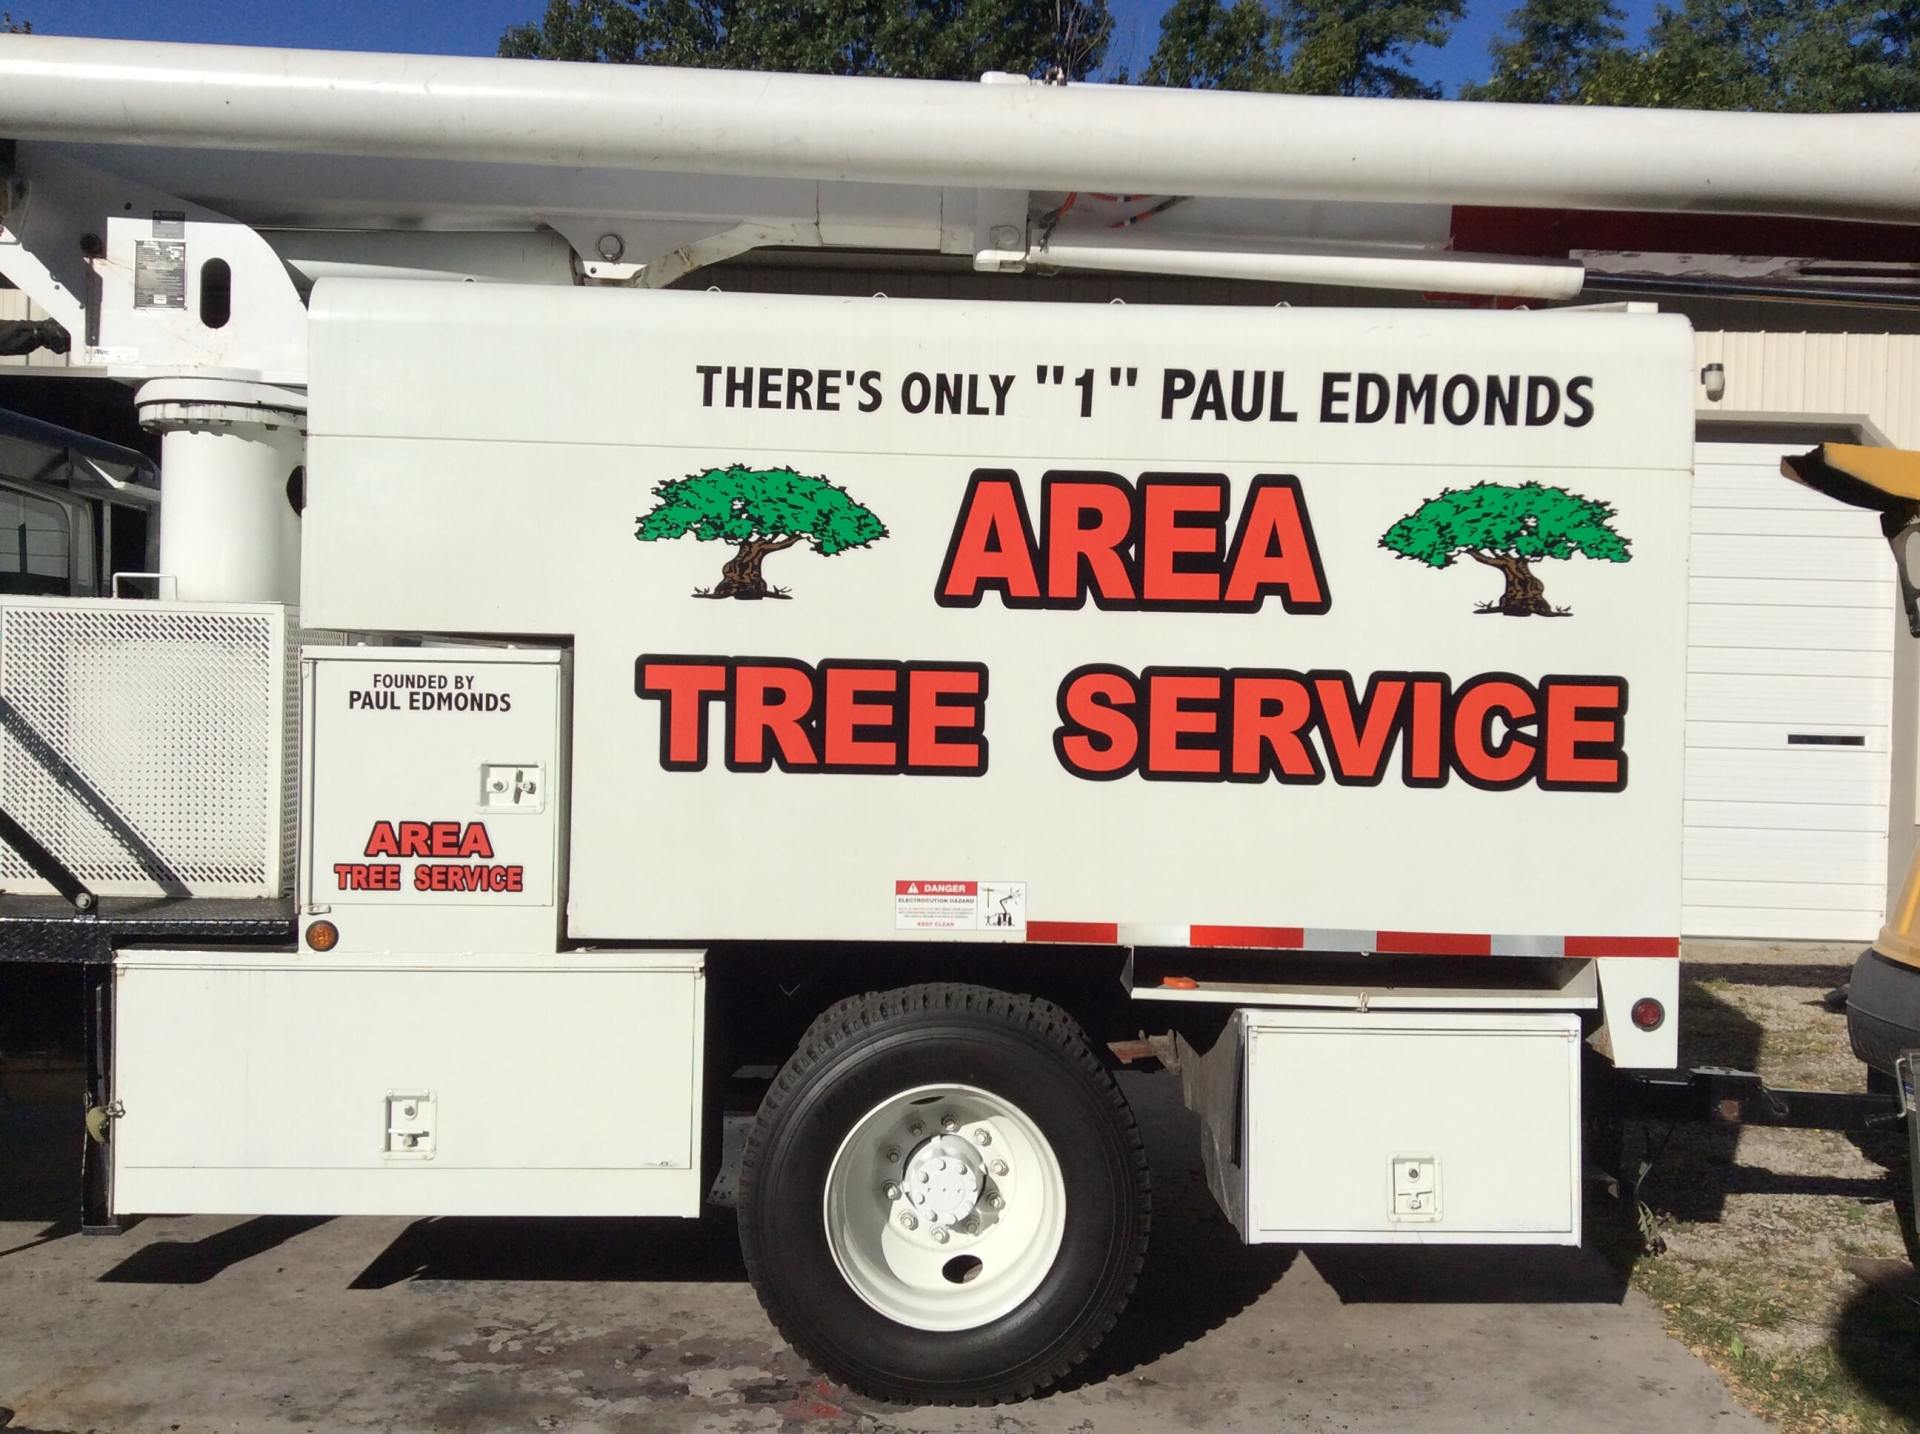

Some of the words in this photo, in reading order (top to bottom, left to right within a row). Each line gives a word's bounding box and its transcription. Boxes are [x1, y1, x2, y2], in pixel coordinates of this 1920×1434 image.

[697, 366, 882, 414] THERE'S
[902, 372, 1015, 416] ONLY
[1037, 365, 1137, 417] "1"
[1162, 369, 1297, 422] PAUL
[1320, 372, 1593, 427] EDMONDS
[935, 468, 1331, 614] AREA
[373, 673, 448, 689] FOUNDED
[454, 675, 475, 690] BY
[349, 690, 401, 710] PAUL
[409, 691, 512, 713] EDMONDS
[635, 654, 988, 776] TREE
[1053, 663, 1629, 793] SERVICE
[363, 820, 496, 859] AREA
[333, 862, 401, 892] TREE
[413, 863, 524, 893] SERVICE
[924, 883, 966, 893] DANGER
